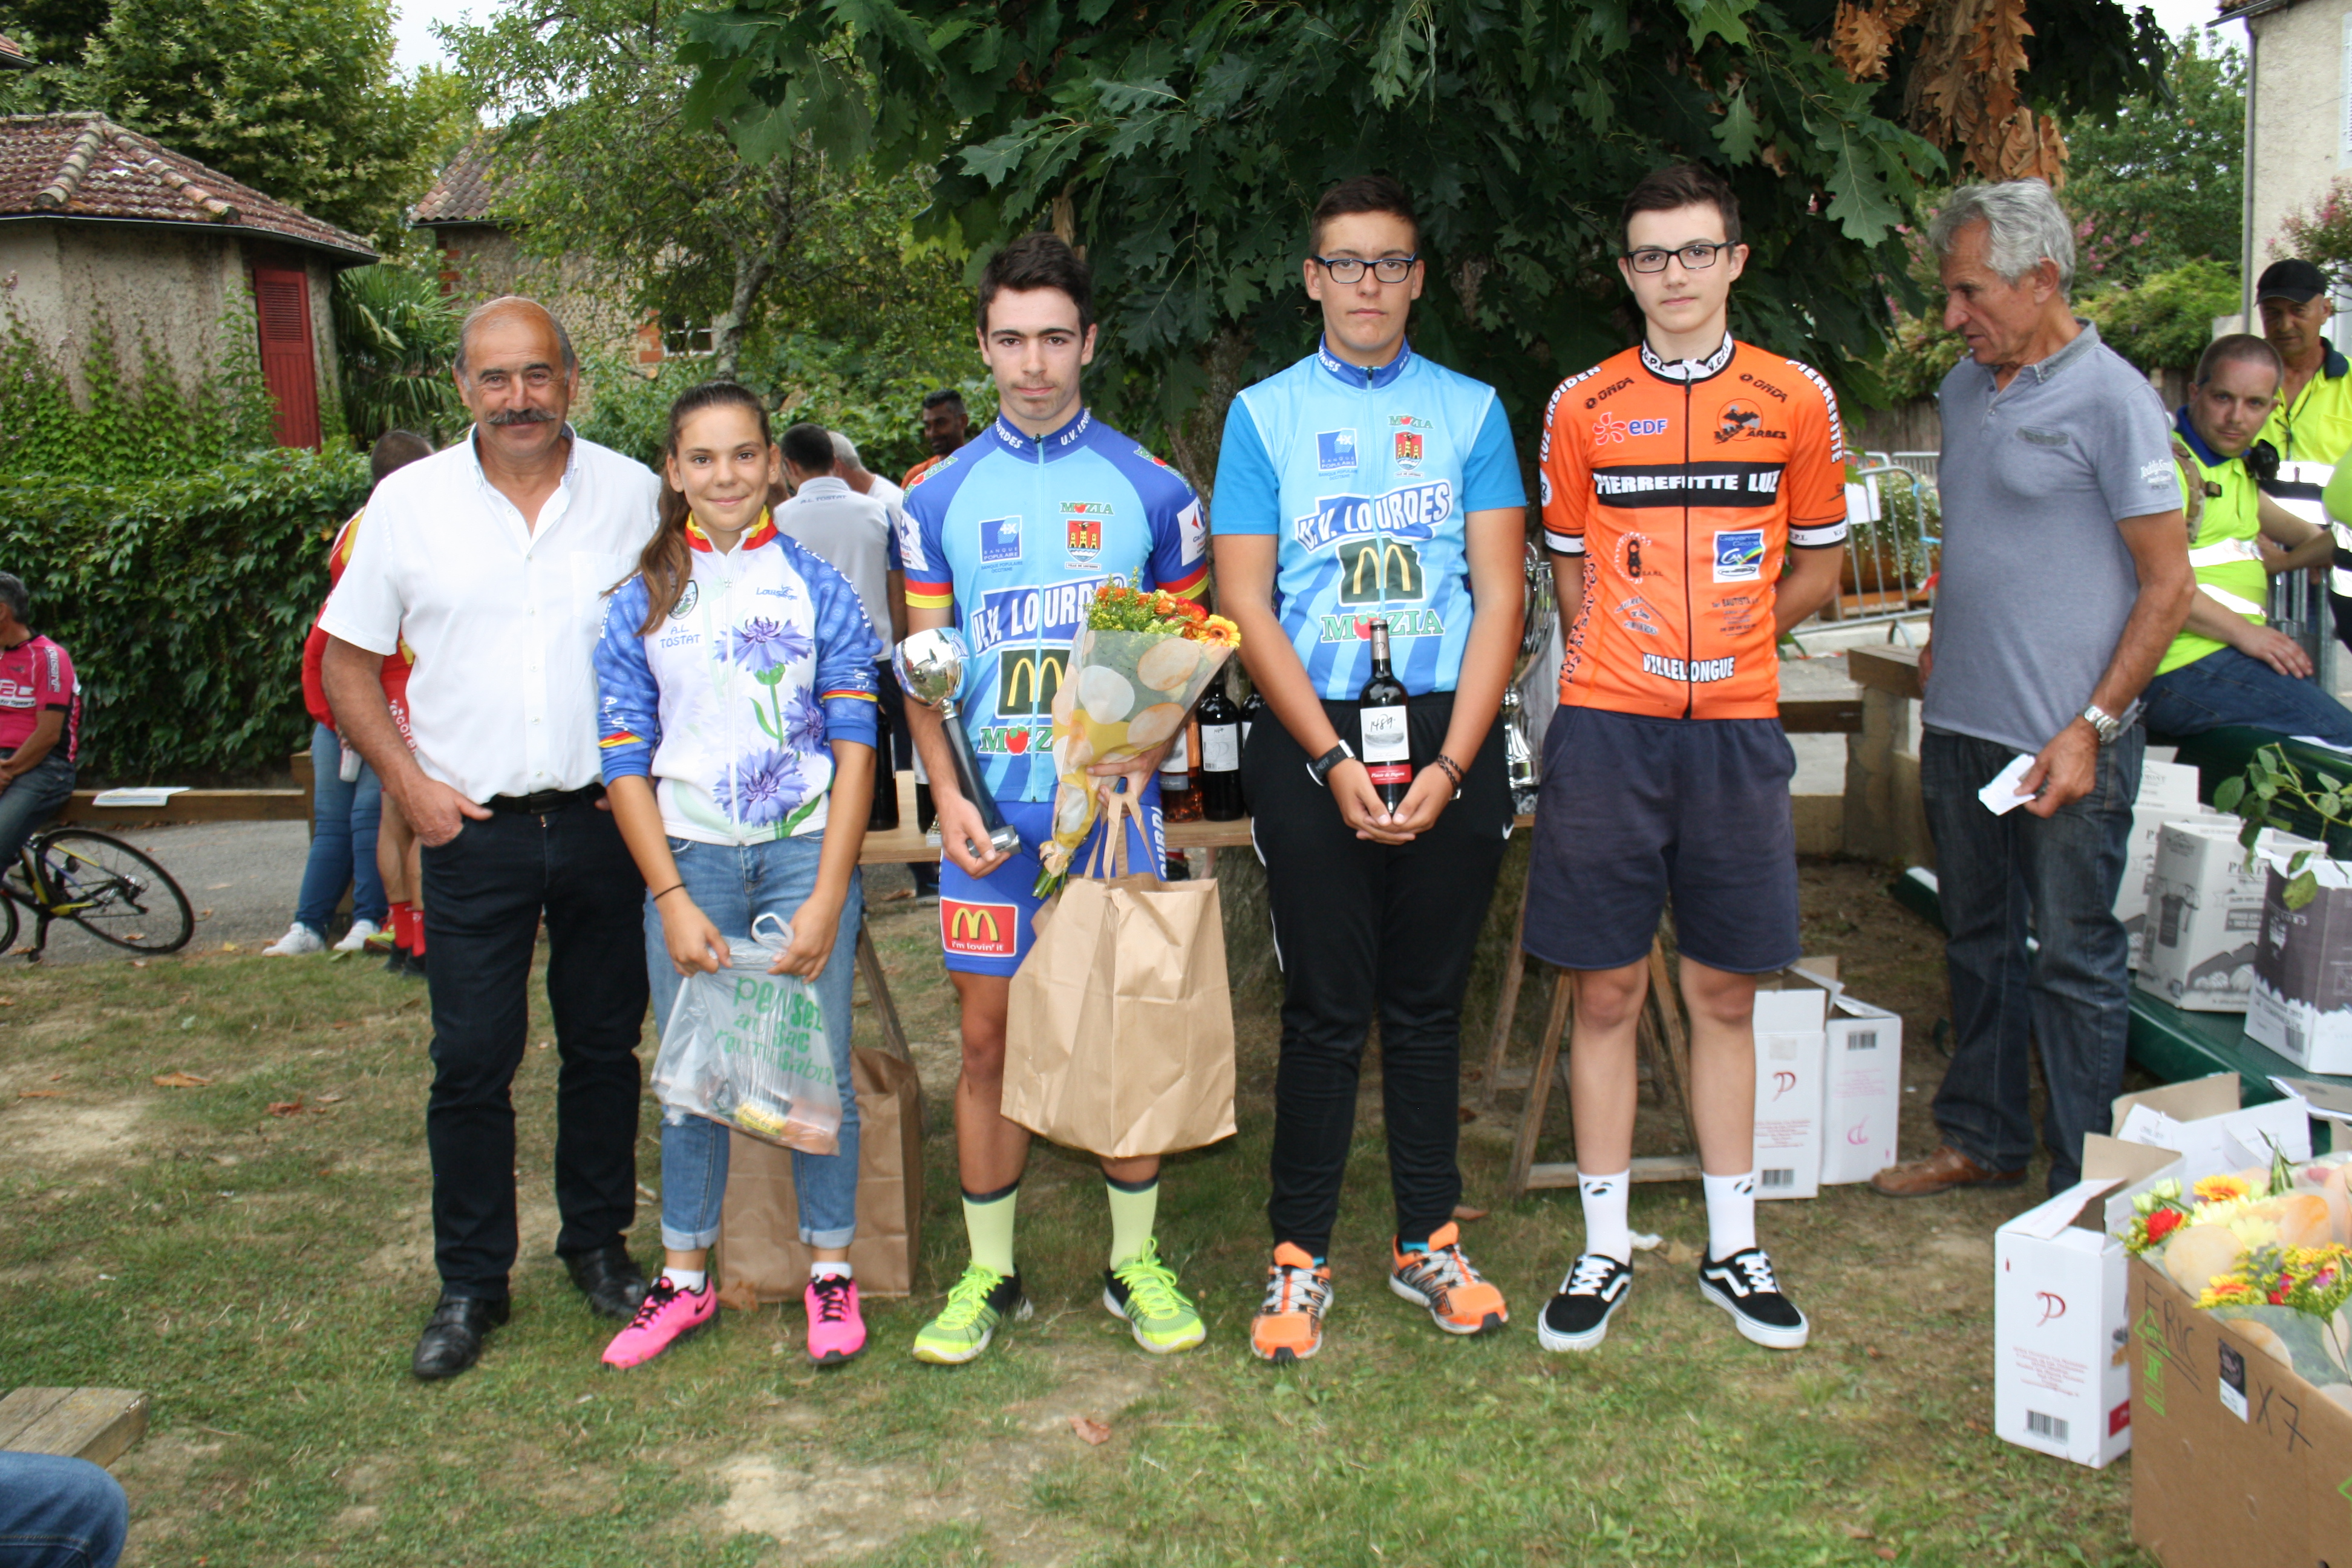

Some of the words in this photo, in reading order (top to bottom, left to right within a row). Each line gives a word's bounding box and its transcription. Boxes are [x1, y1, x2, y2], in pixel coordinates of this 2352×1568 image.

[1545, 365, 1602, 428] ARDIDEN
[1060, 430, 1078, 446] U.V.
[1540, 431, 1551, 463] LUZ
[1592, 472, 1739, 495] PIERREFITTE
[1748, 470, 1781, 494] LUZ
[1344, 483, 1449, 532] LOURDES
[984, 546, 1018, 555] BANQUE
[984, 552, 1018, 561] POPULAIRE
[659, 634, 701, 649] TOSTAT
[1642, 653, 1736, 683] VILLELONGUE
[1315, 757, 1330, 772] NEFF
[951, 941, 965, 950] i'm
[967, 942, 995, 952] lovin'
